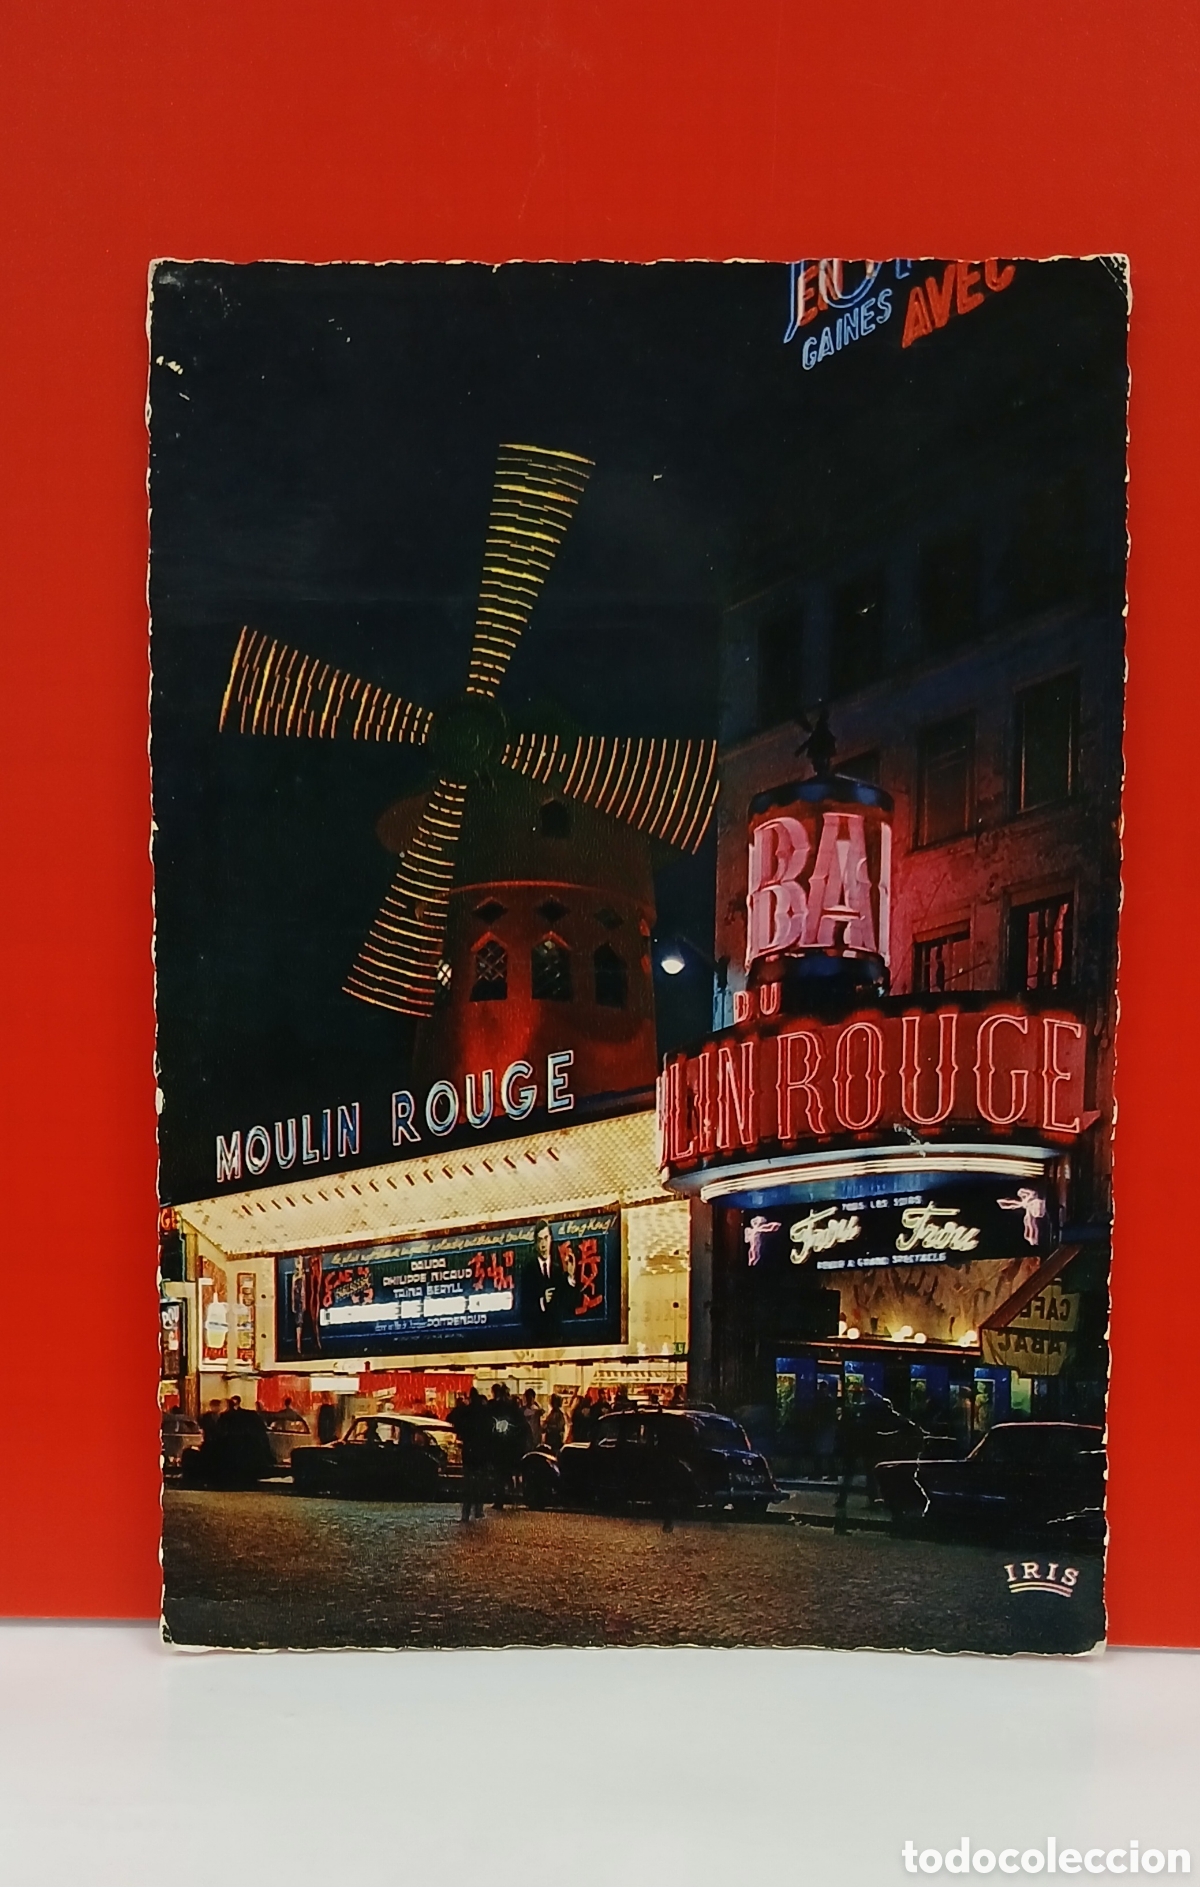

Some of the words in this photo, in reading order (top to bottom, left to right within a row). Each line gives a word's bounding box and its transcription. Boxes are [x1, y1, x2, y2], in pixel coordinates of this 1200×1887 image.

[802, 288, 893, 370] GAINES
[900, 258, 1014, 349] AVEC
[733, 982, 781, 1023] DU
[776, 1014, 1083, 1140] ROUGE
[215, 1102, 360, 1183] MOULIN
[391, 1050, 575, 1146] ROUGE
[870, 1200, 889, 1210] LES
[790, 1206, 862, 1264] Frou
[896, 1201, 981, 1252] Frou
[891, 1252, 947, 1264] SPECTACLE
[383, 1273, 427, 1286] PHILIPPE
[431, 1268, 473, 1282] NICAUD
[1004, 1561, 1080, 1587] IRIS
